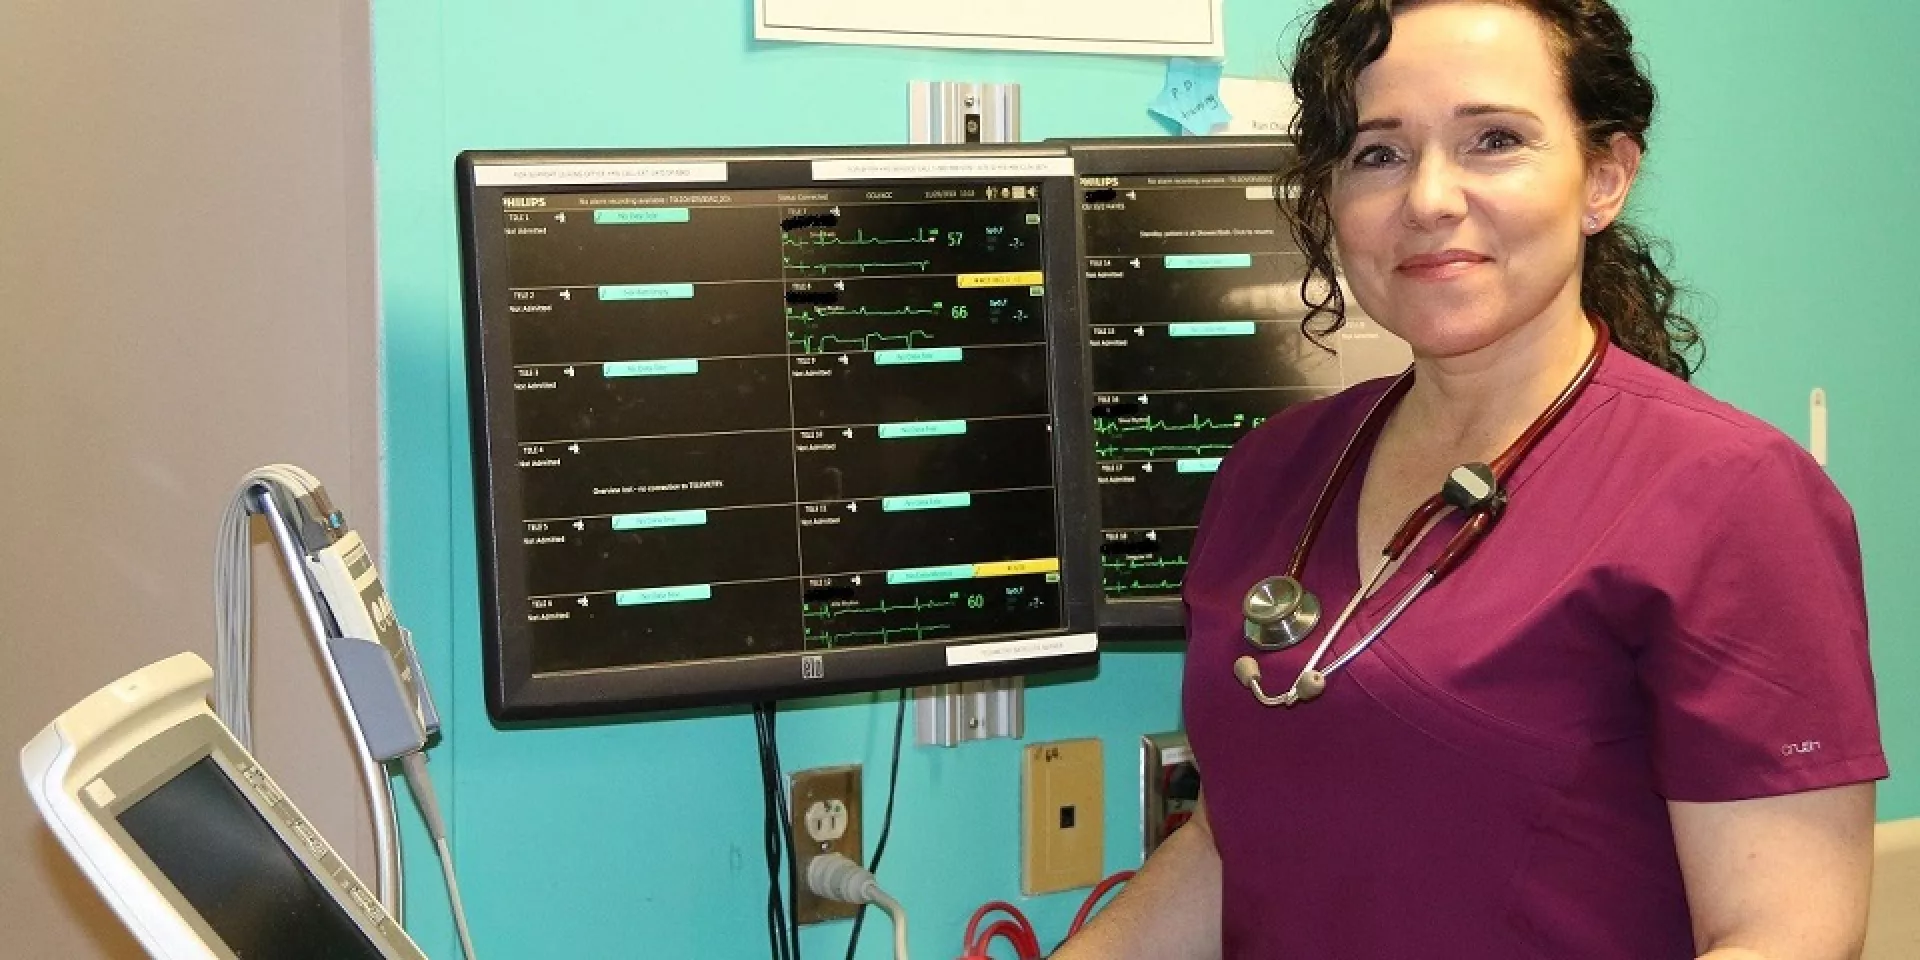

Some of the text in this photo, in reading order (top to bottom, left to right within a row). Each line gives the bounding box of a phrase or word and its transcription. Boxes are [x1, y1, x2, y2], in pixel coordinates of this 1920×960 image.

[948, 231, 963, 247] 57
[952, 305, 968, 319] 66
[968, 594, 985, 609] 60
